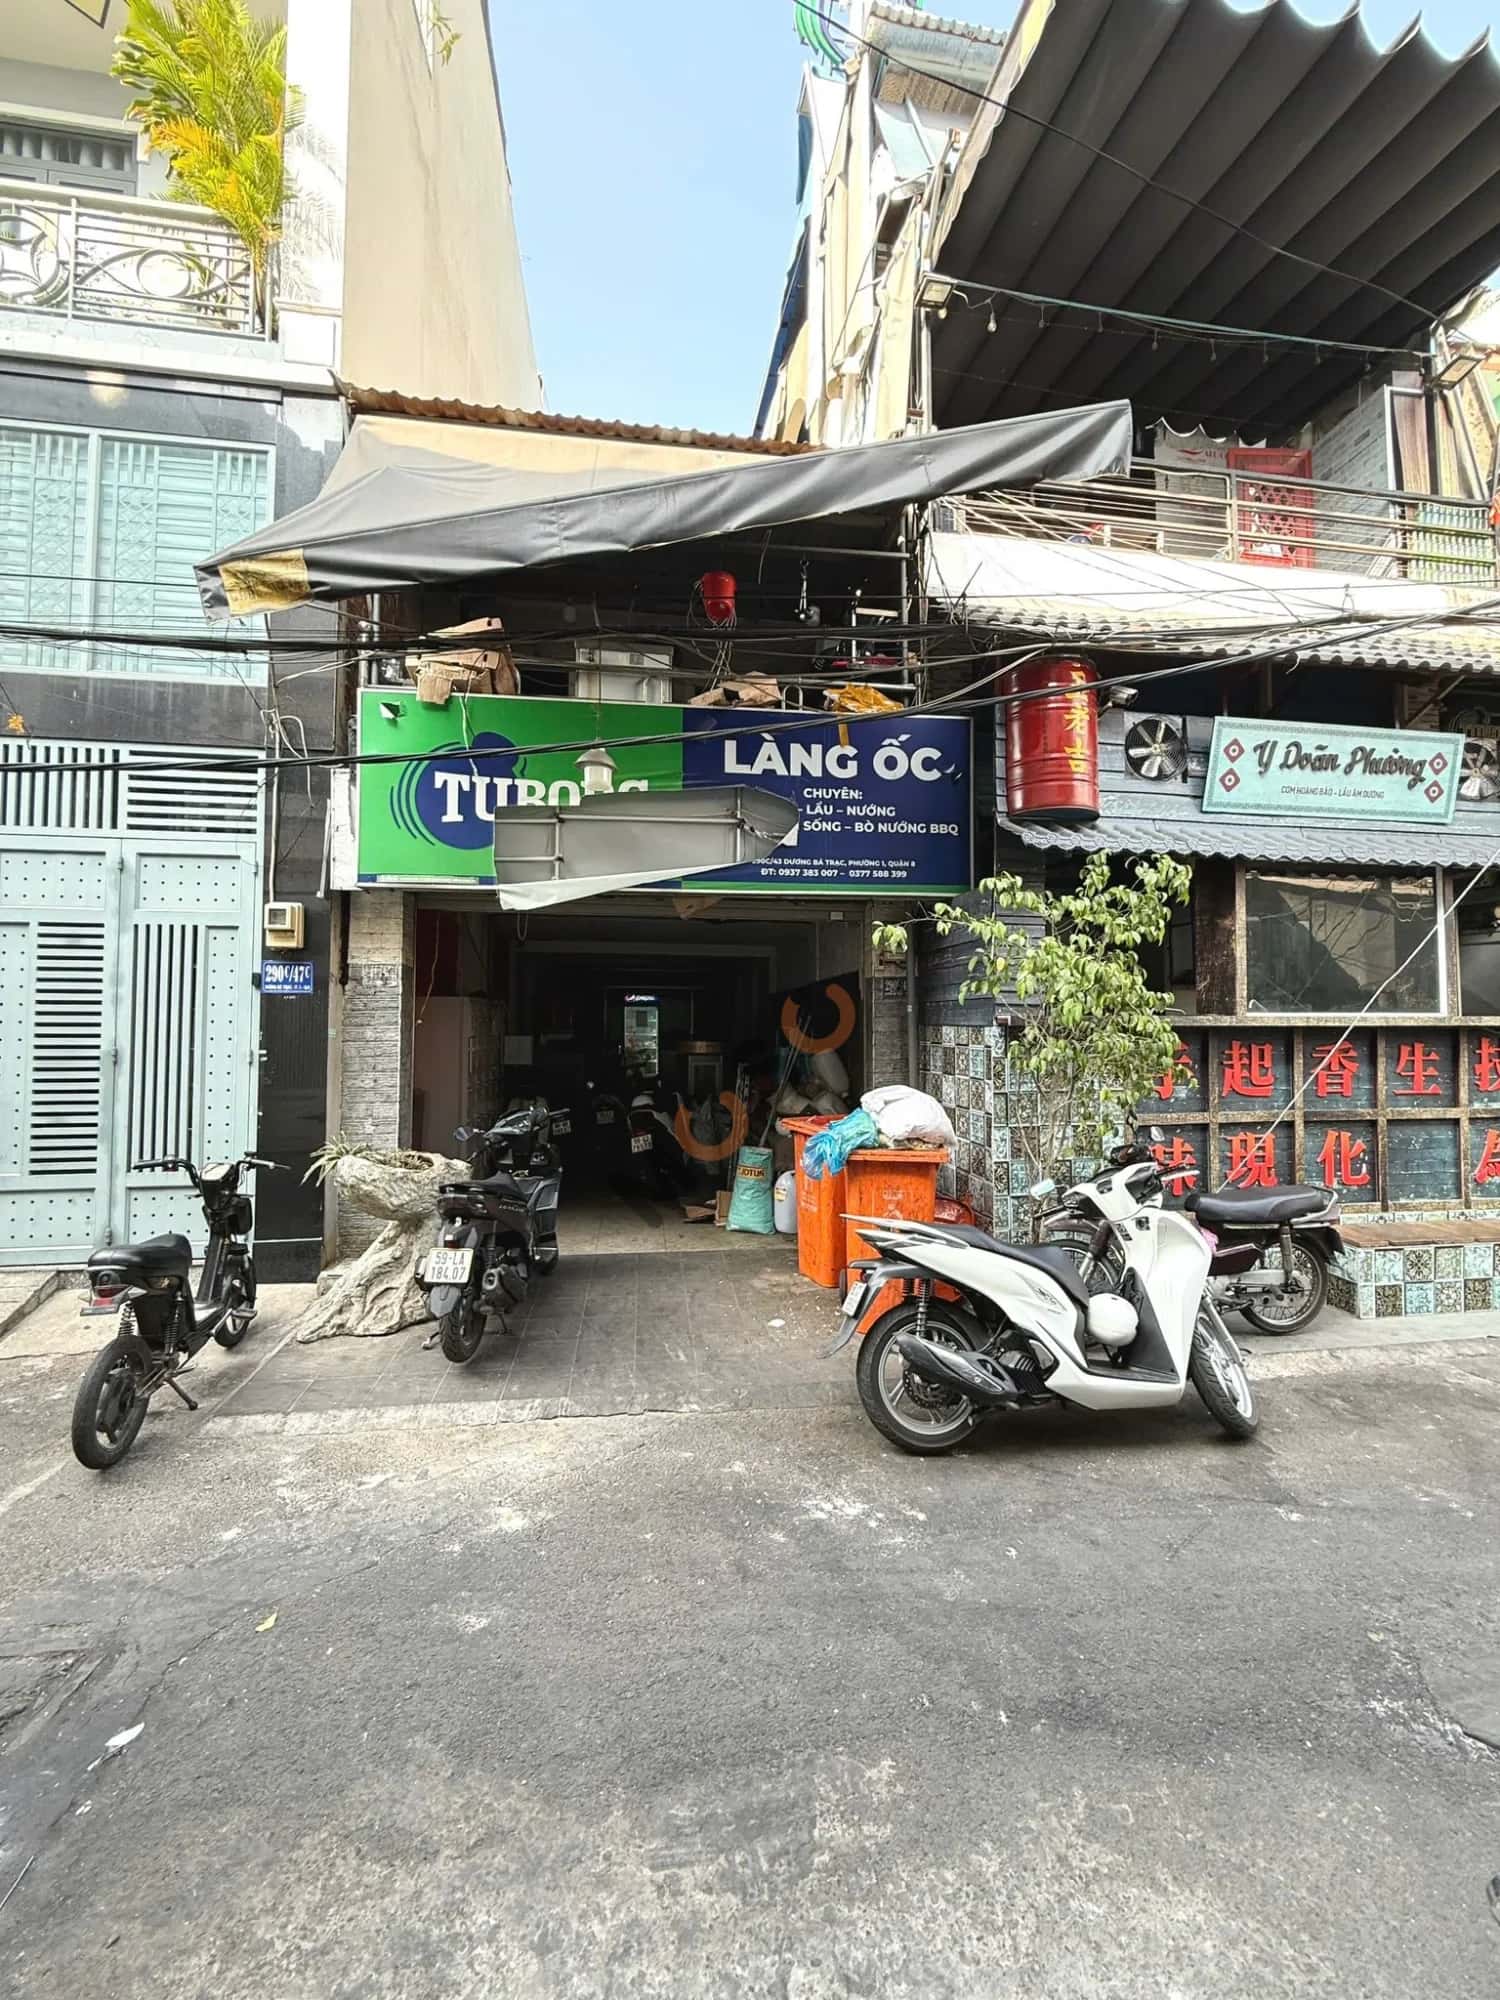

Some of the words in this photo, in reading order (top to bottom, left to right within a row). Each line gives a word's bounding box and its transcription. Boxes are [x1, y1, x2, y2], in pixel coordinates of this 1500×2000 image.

[724, 732, 858, 779] LÀNG
[872, 734, 943, 782] ỐC
[1280, 740, 1341, 773] Doãn
[434, 771, 648, 824] TUBO
[803, 787, 863, 800] CHUYÊN:
[846, 804, 896, 817] NƯỚNG
[803, 817, 841, 832] SỐNG
[855, 820, 875, 834] BÒ
[878, 820, 927, 834] NƯỚNG
[930, 823, 960, 836] BBQ
[760, 868, 777, 876] ĐT:
[778, 868, 800, 877] 0937
[802, 868, 818, 877] 383
[820, 869, 838, 878] 007
[849, 869, 870, 878] 0377
[890, 870, 907, 879] 399
[434, 1251, 465, 1265] 59-LA
